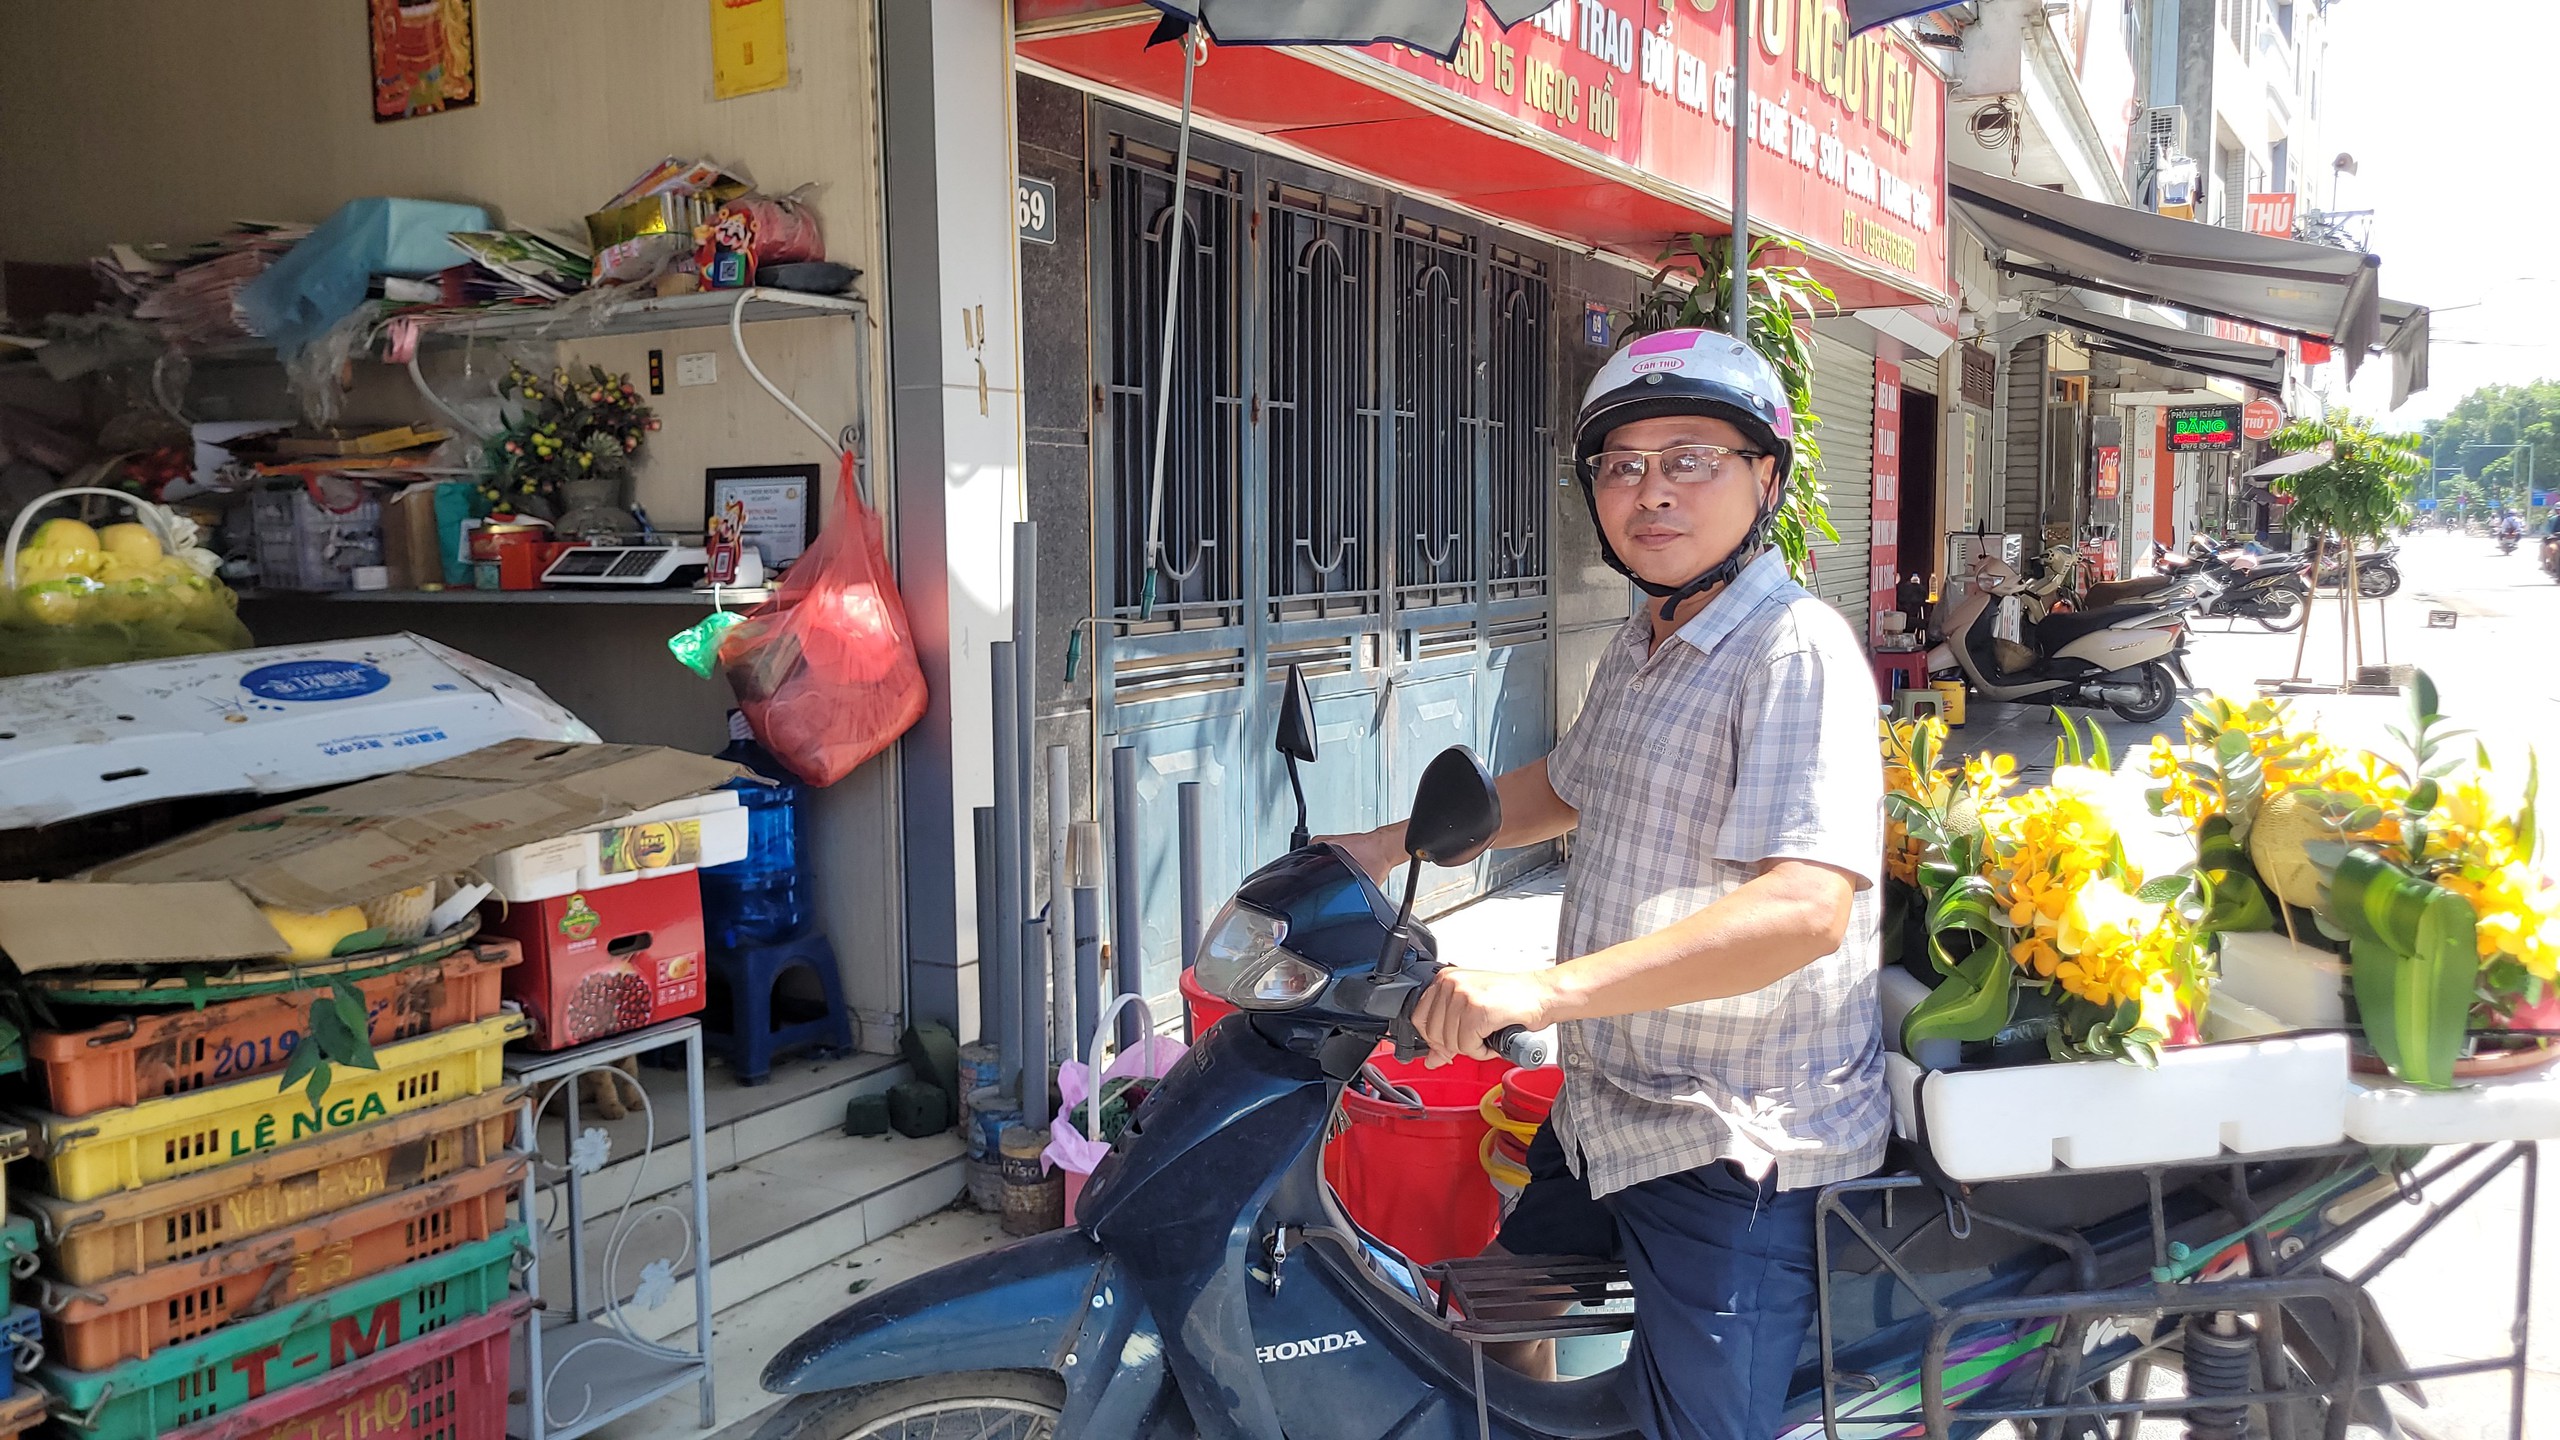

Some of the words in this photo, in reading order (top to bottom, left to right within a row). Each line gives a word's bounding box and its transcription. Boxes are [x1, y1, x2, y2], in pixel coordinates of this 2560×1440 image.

[1491, 40, 1514, 95] 15
[1525, 54, 1580, 127] NGỌC
[1588, 70, 1619, 142] HỒI
[1578, 0, 1633, 73] TRAO
[1641, 19, 1674, 95] ĐỔI
[1678, 50, 1708, 113] GIA
[1714, 66, 1756, 139] CÔG
[1759, 89, 1790, 156] CHẾ
[1842, 209, 1856, 248] ĐT
[2247, 196, 2291, 232] THÚ
[2176, 417, 2228, 434] RĂNG
[2245, 416, 2264, 429] THÚ
[2267, 418, 2274, 429] Y
[2100, 451, 2119, 472] Café
[213, 1030, 300, 1080] 2019
[292, 1091, 387, 1140] NGA
[1256, 1330, 1367, 1363] HONDA
